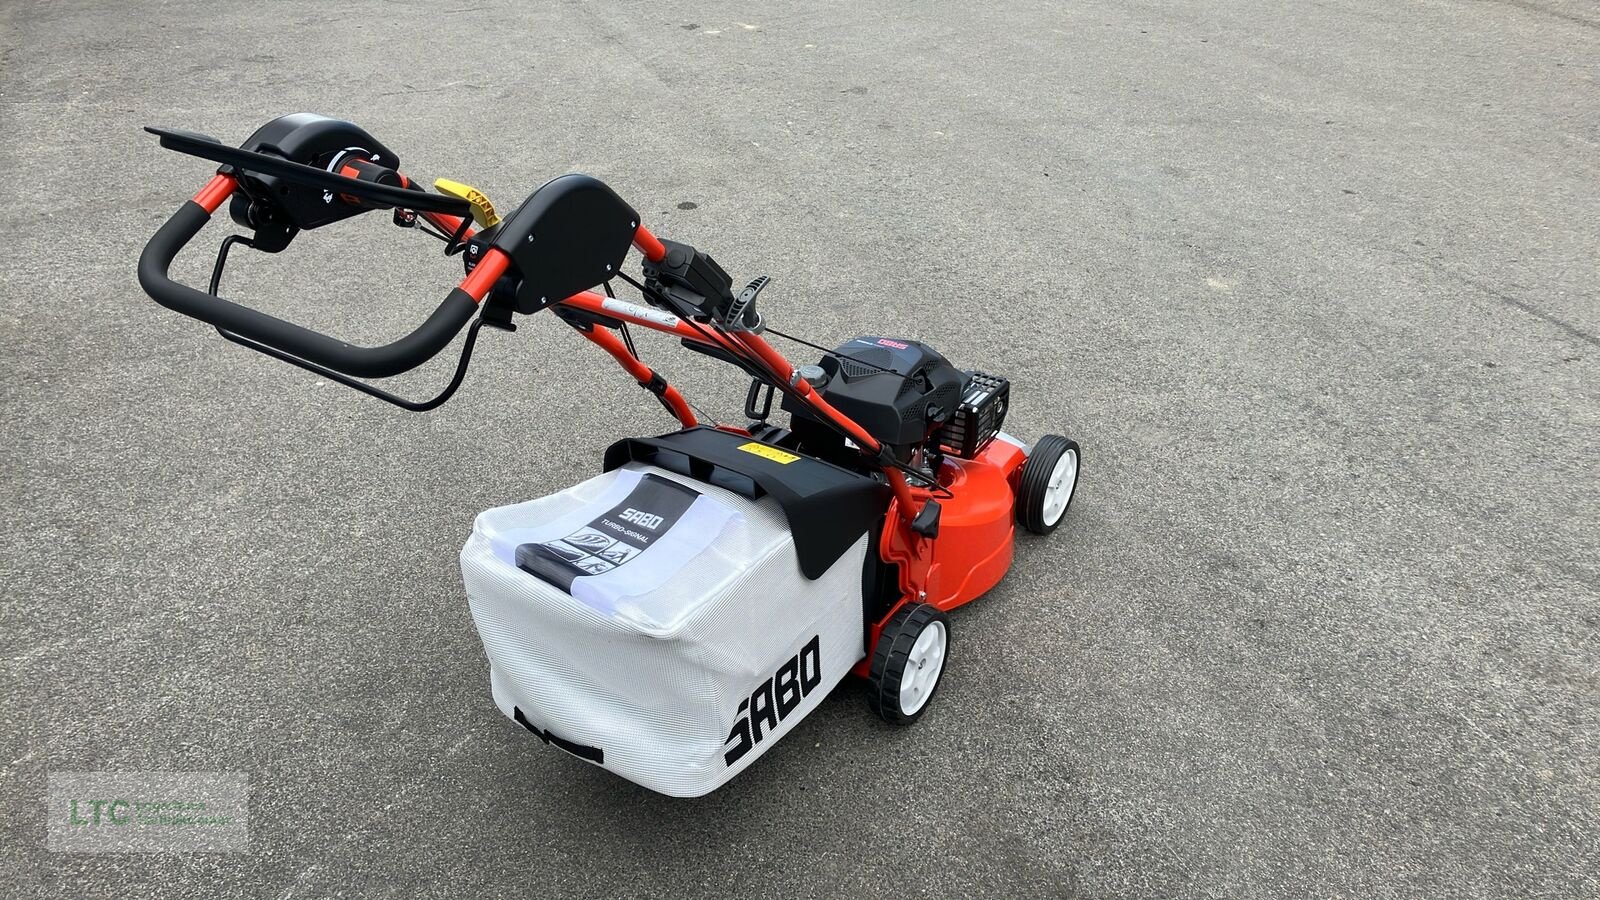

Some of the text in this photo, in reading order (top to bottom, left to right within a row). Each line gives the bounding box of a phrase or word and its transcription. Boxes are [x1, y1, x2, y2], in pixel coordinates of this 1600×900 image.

[601, 518, 649, 543] TURBO-SIGNAL
[618, 507, 664, 530] SABO
[724, 634, 821, 767] SABO
